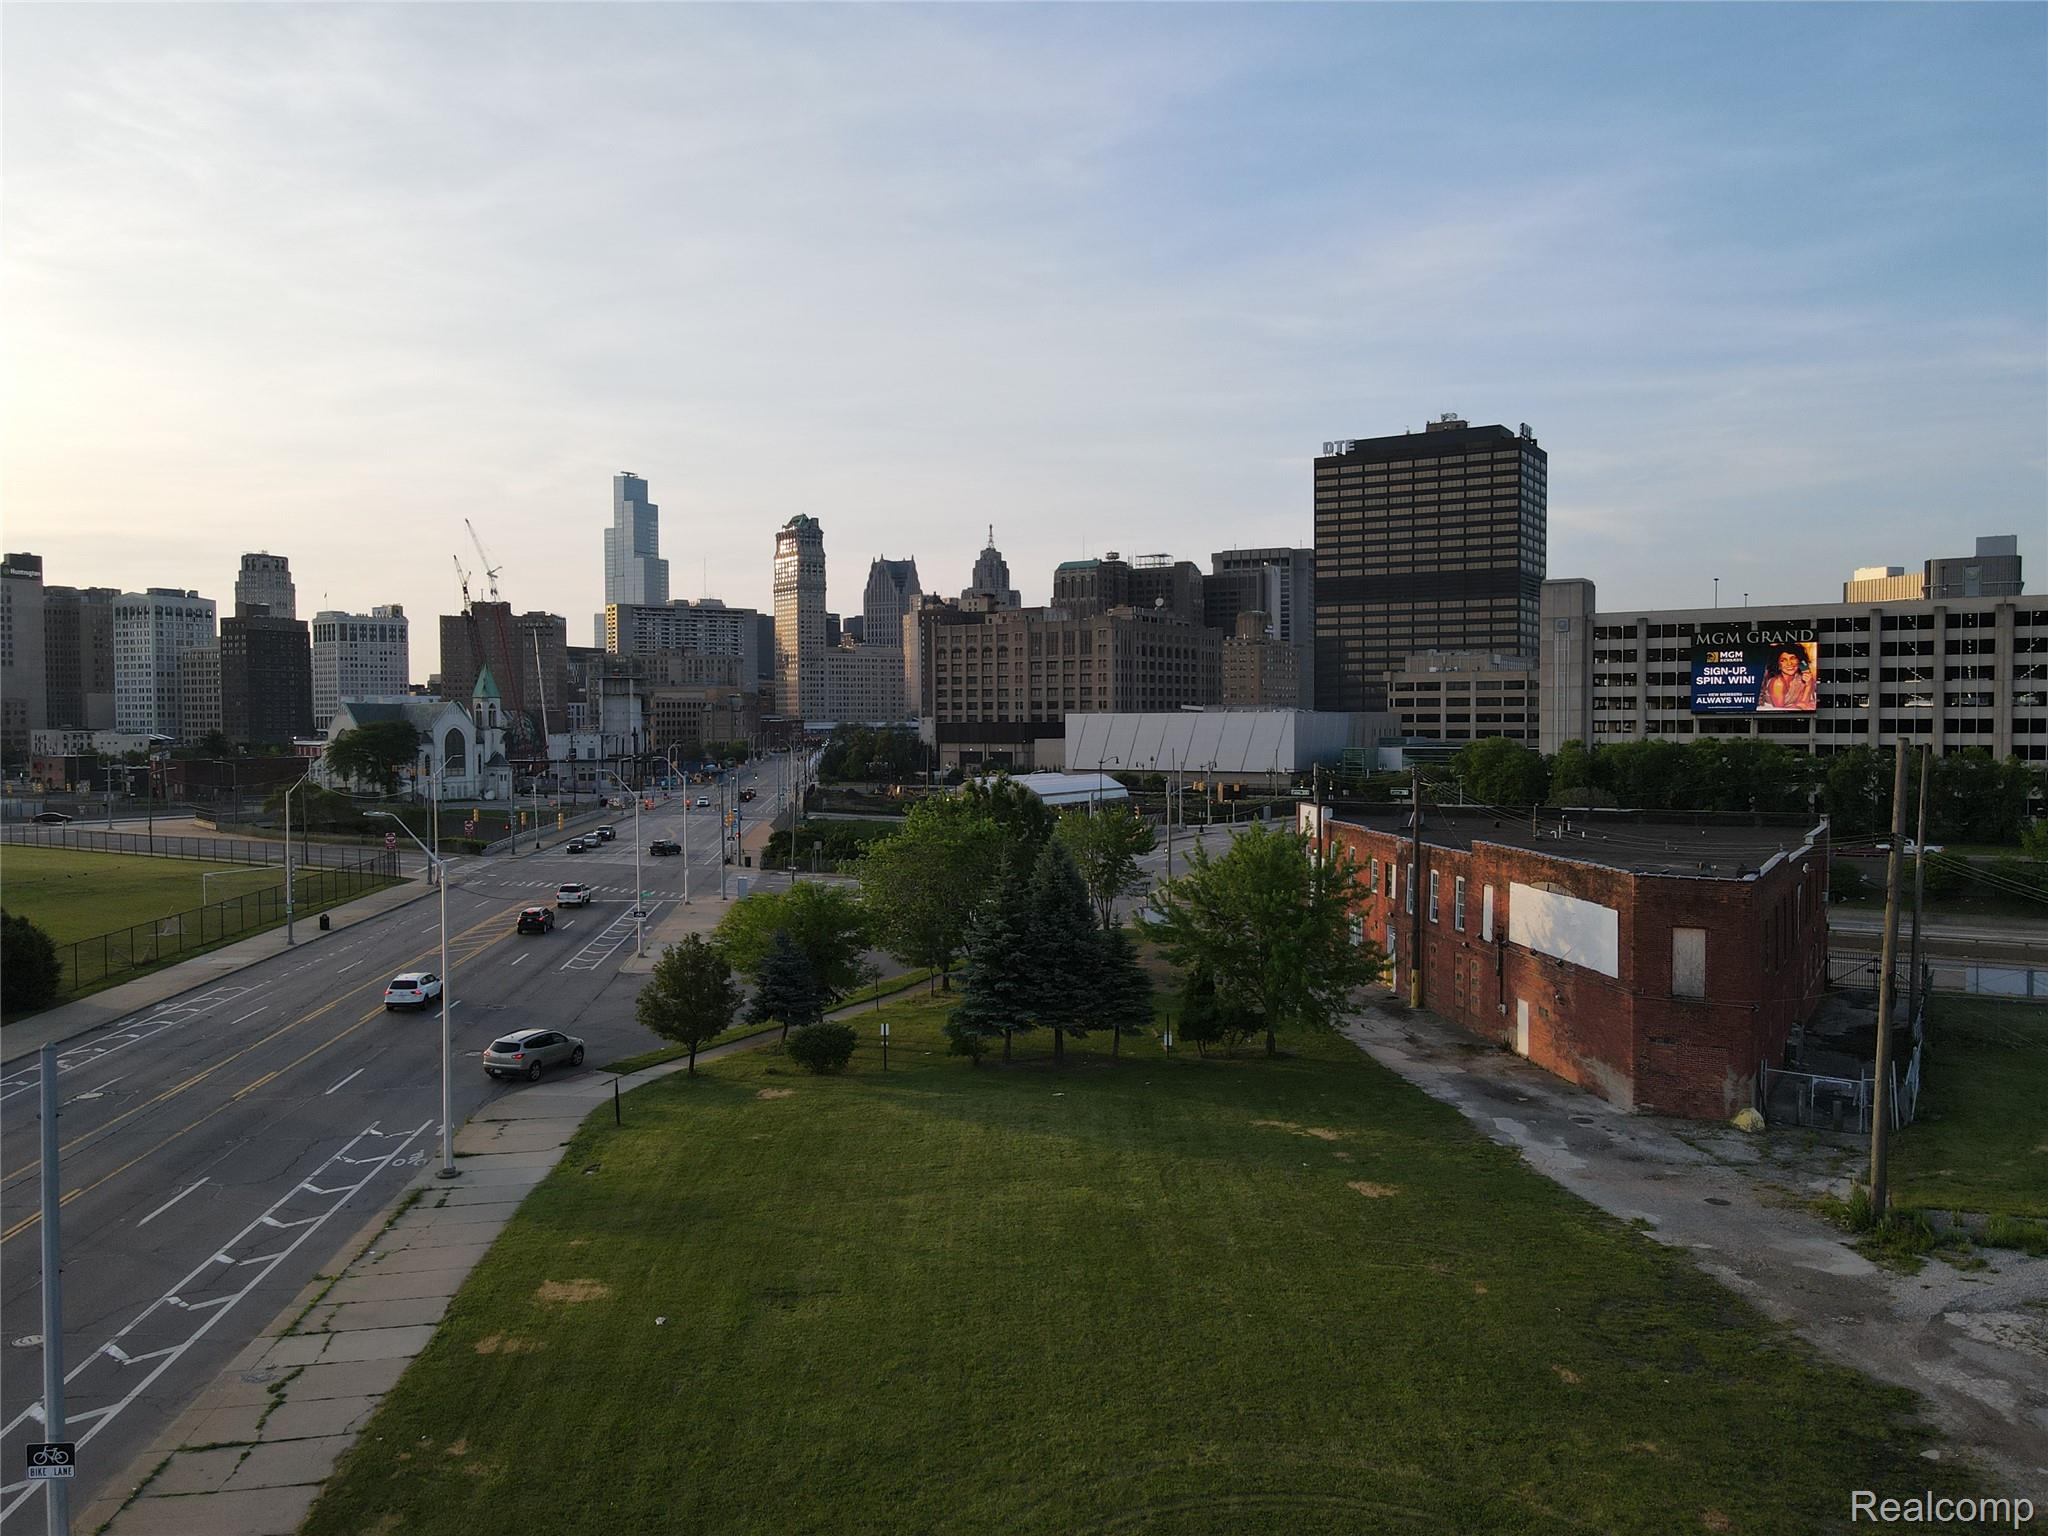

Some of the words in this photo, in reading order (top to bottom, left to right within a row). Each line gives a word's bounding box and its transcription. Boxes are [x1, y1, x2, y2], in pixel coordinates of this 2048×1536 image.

[1323, 440, 1355, 454] DTE
[1696, 632, 1740, 645] MGM
[1747, 629, 1814, 644] GRAND
[1720, 651, 1743, 659] MGM
[1703, 667, 1747, 676] SIGN-UP.
[1696, 676, 1725, 685] SPIN.
[1728, 675, 1755, 684] WIN!
[1734, 696, 1755, 704] WIN!
[30, 1468, 47, 1477] BIKE
[54, 1467, 72, 1476] LANE
